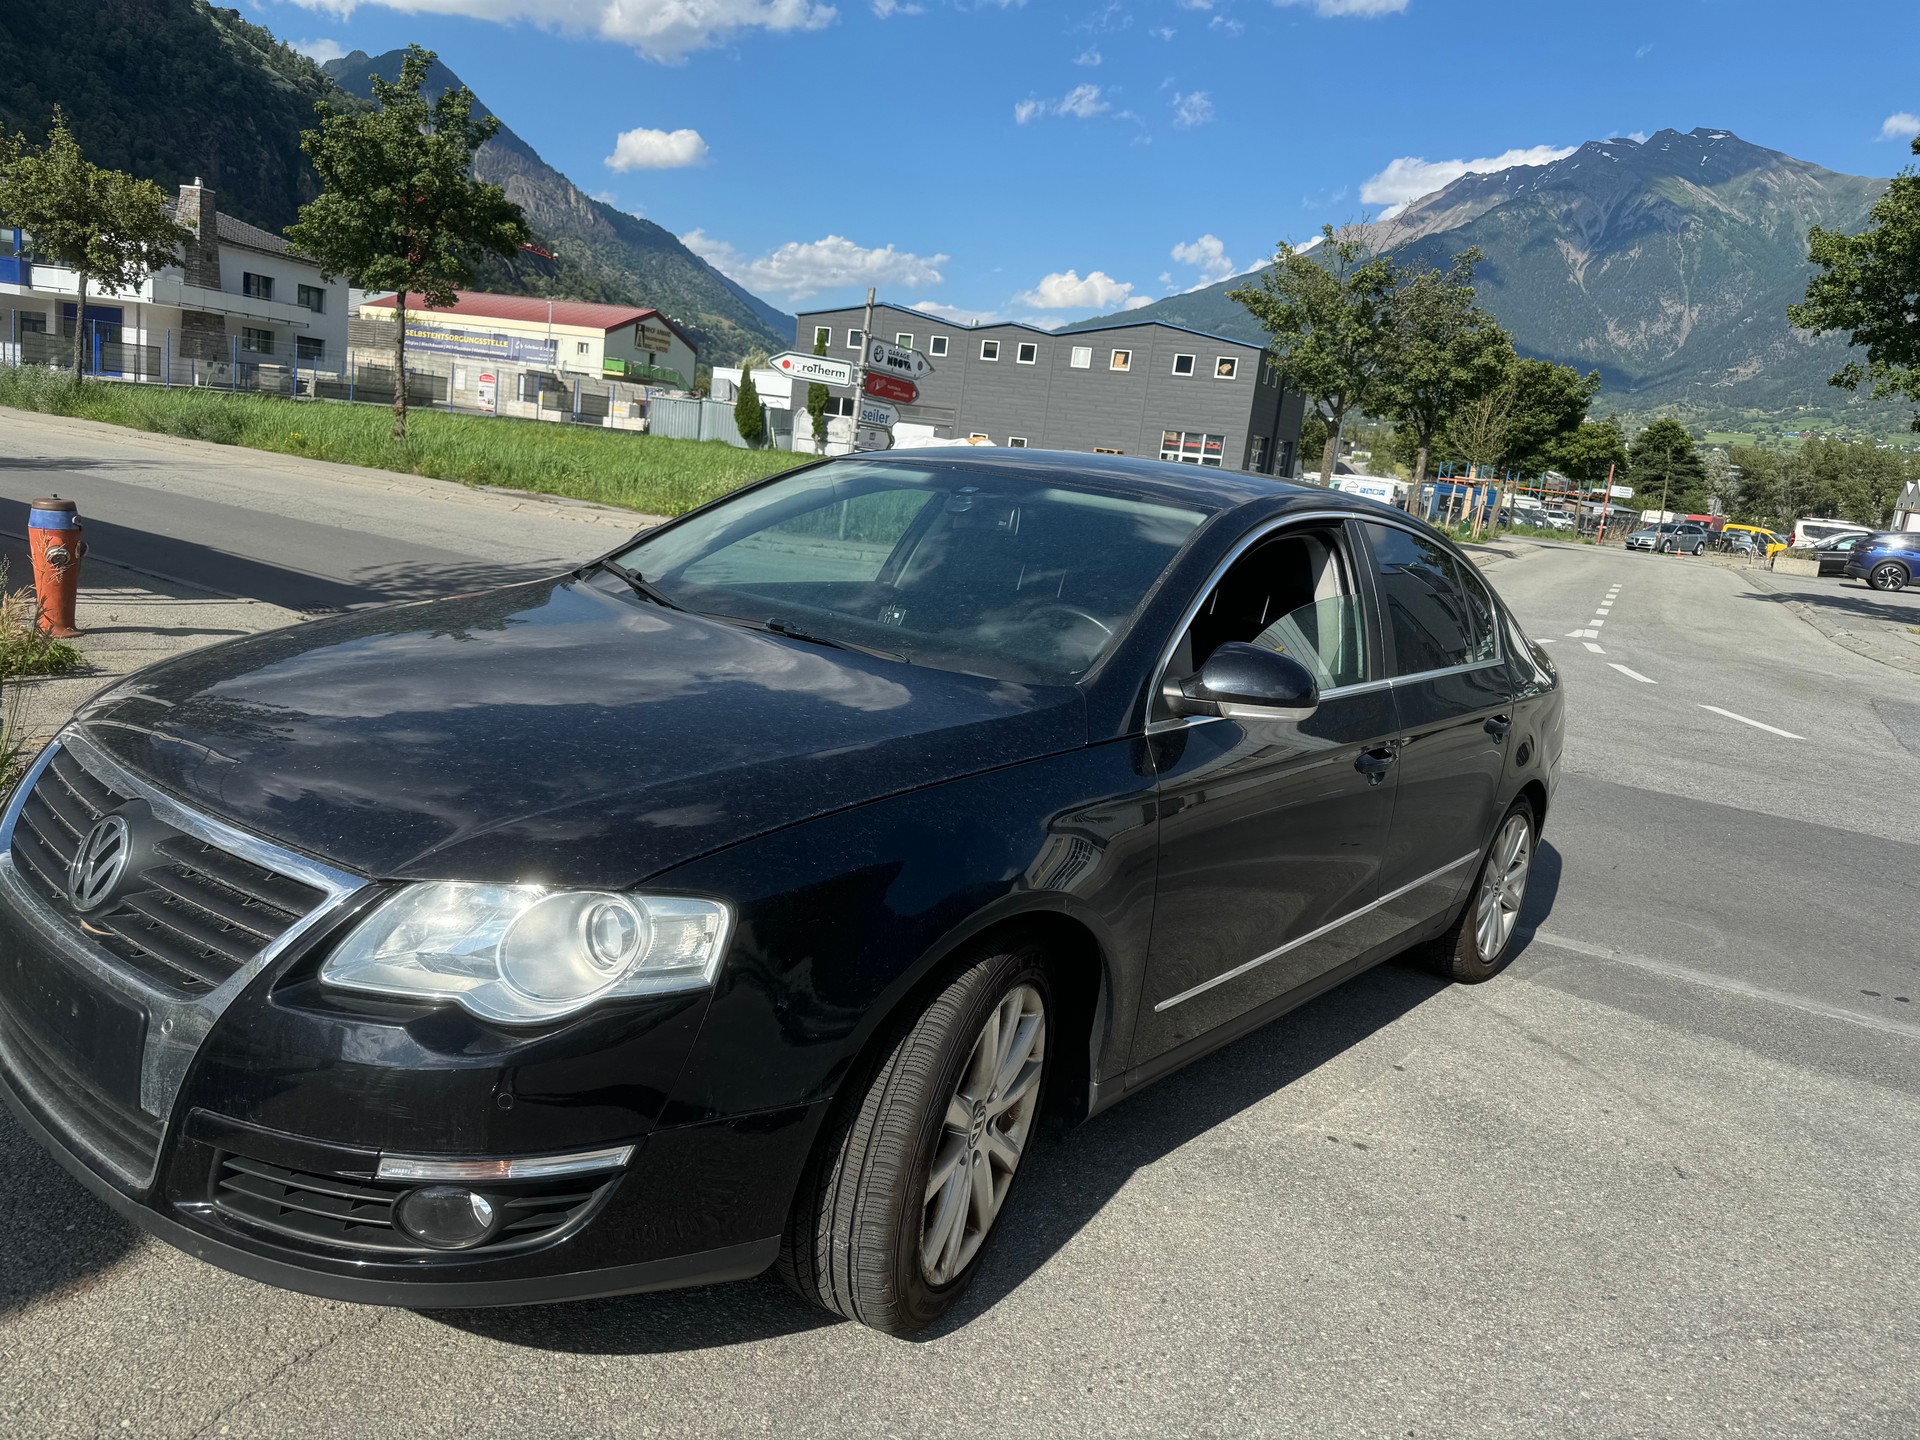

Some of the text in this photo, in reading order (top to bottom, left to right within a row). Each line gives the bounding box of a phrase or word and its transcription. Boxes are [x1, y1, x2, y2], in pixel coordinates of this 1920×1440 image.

[405, 329, 509, 348] SELBSTENTSORGUNGSSTELLE
[888, 349, 911, 360] GARAGE
[793, 363, 846, 378] roTherm
[887, 356, 912, 371] NUOVA
